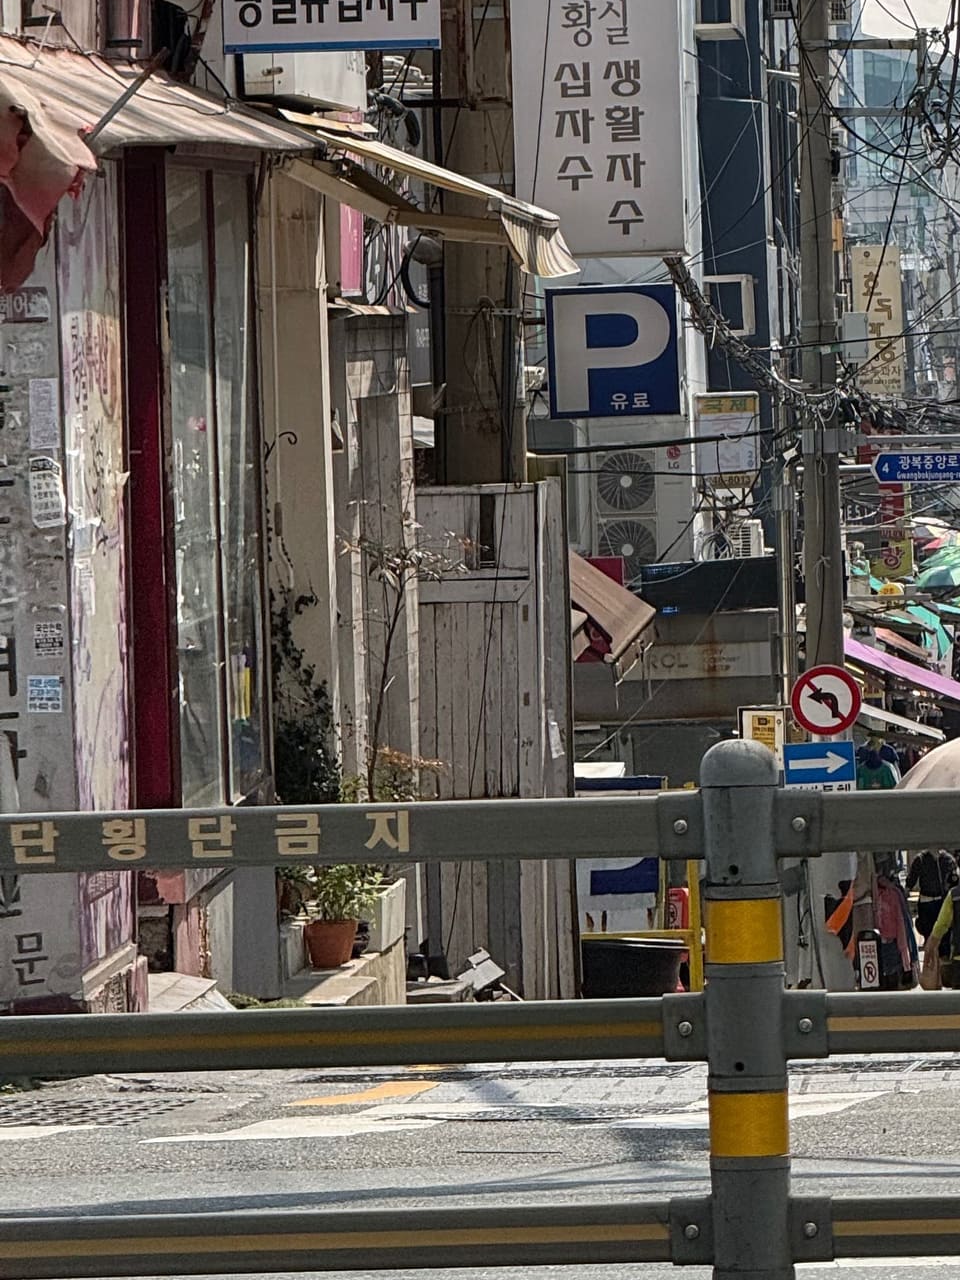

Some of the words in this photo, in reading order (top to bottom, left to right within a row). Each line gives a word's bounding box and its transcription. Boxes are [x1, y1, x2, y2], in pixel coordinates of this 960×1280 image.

[553, 60, 595, 192] 십자수
[602, 58, 646, 235] 생활자수
[609, 391, 651, 409] 유료
[882, 463, 890, 473] 4
